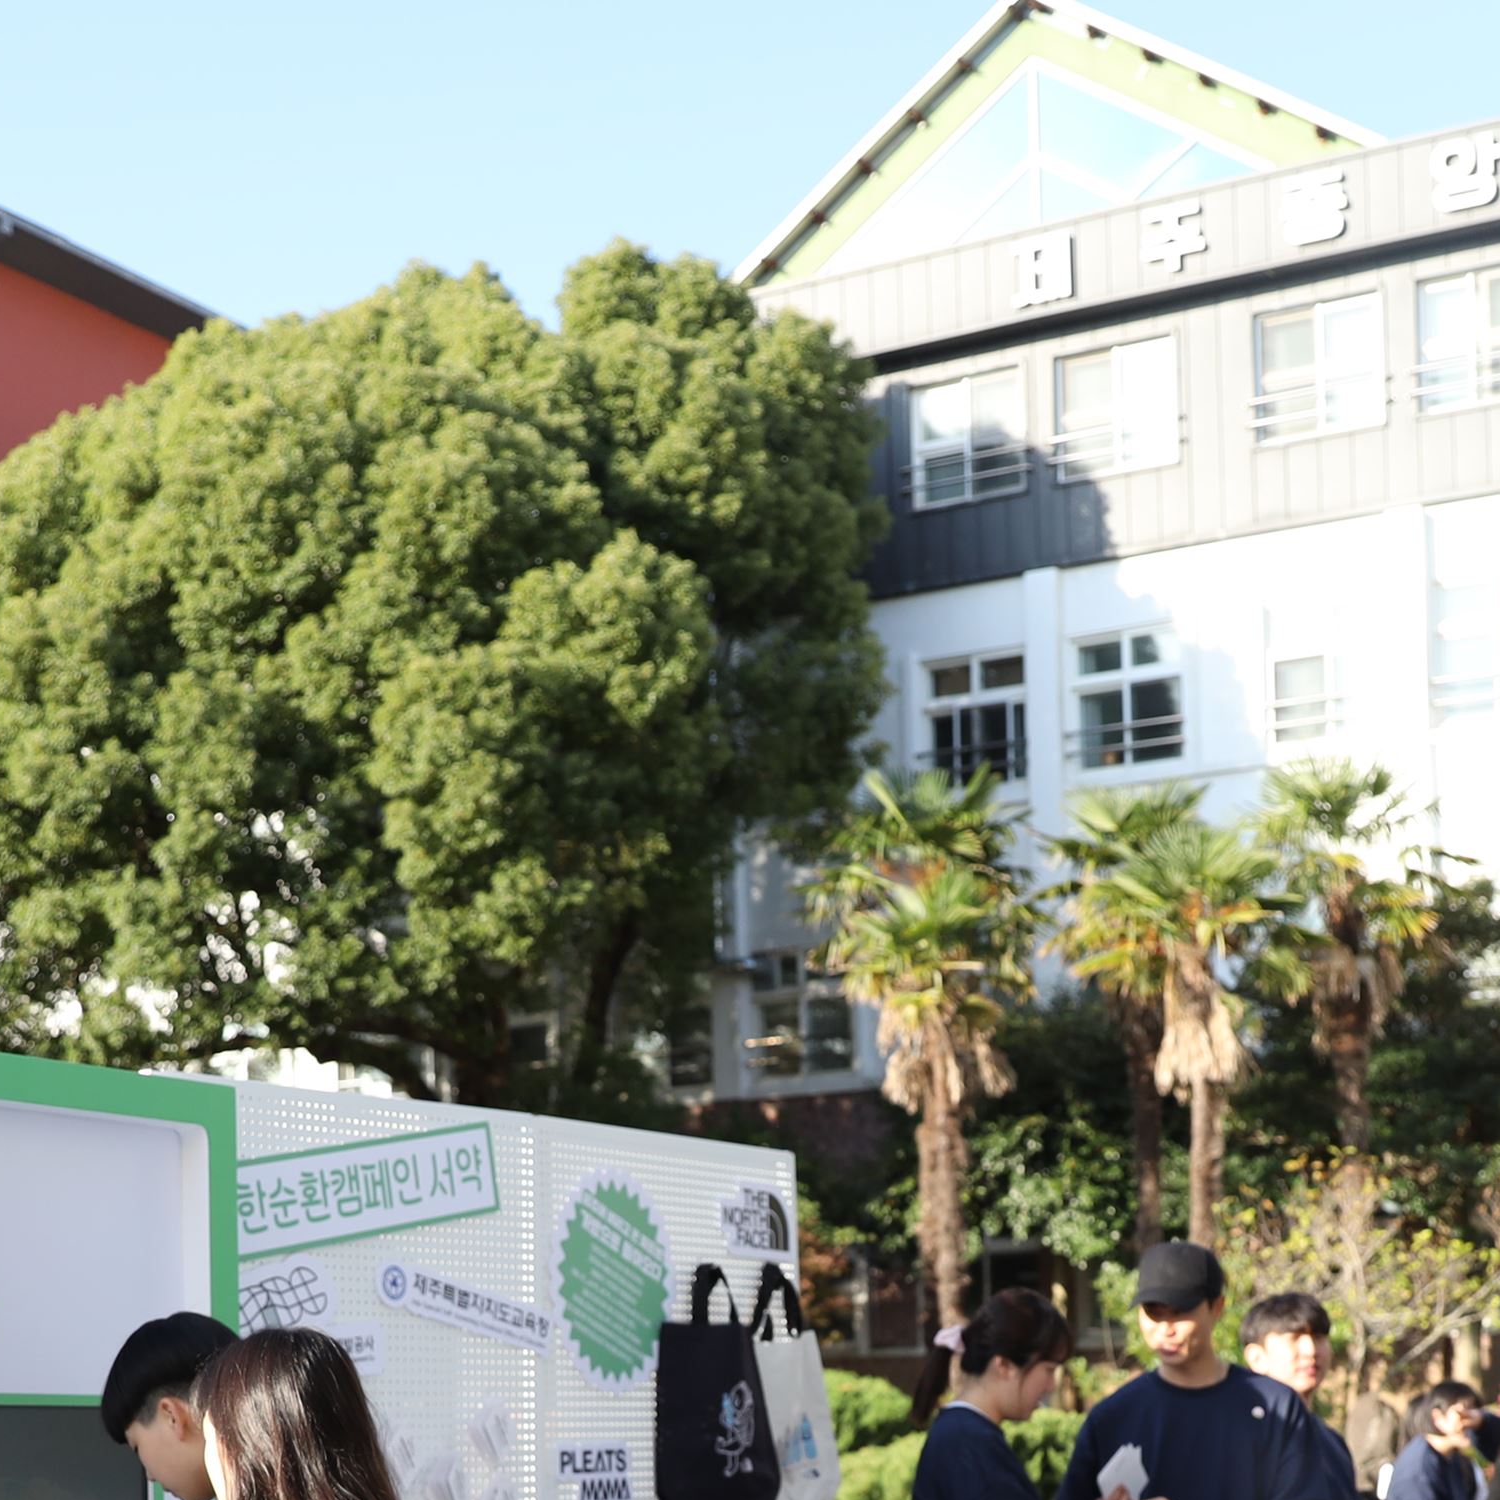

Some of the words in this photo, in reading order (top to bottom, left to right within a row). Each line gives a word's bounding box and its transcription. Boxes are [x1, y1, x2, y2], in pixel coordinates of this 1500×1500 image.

[430, 1143, 483, 1198] 서약
[743, 1188, 770, 1209] THE
[723, 1207, 770, 1230] NORTH
[737, 1227, 770, 1249] FACE
[413, 1272, 550, 1339] 제주특별자치도교육청
[560, 1448, 627, 1474] PLEATS
